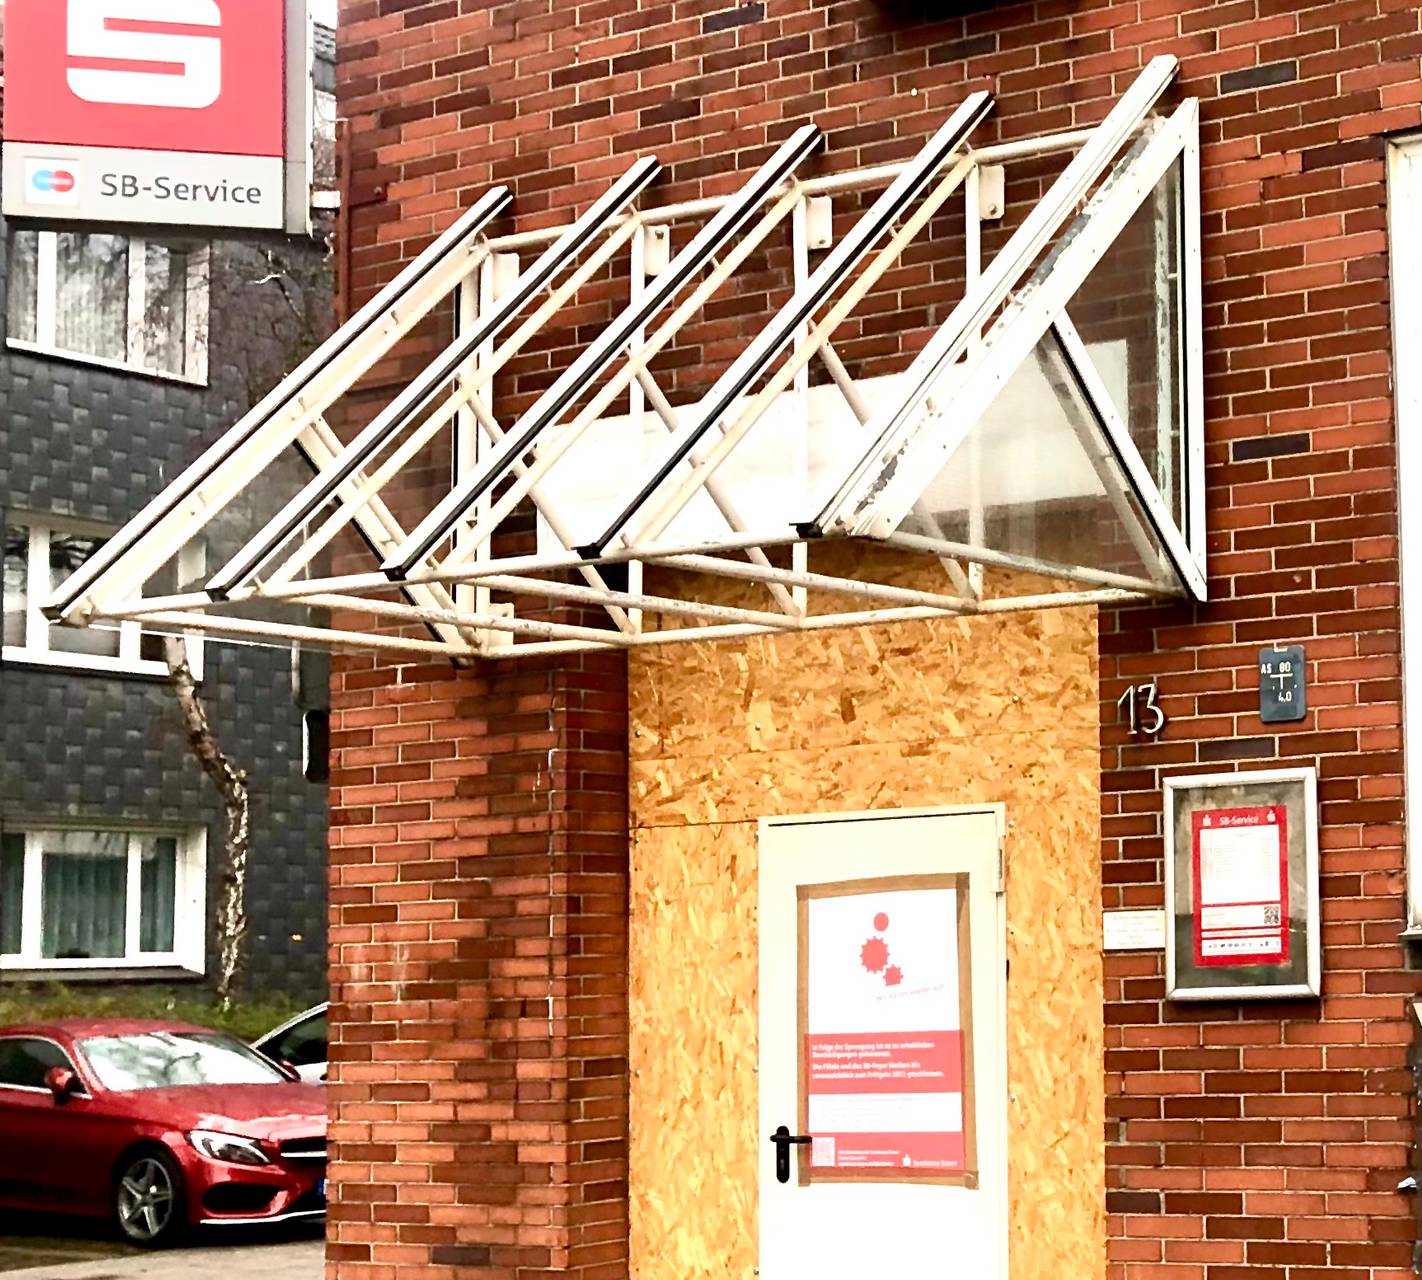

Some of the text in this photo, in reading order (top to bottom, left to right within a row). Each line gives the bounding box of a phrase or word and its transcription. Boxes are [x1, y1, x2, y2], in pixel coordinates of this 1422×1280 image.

[101, 173, 262, 204] SB-Service
[1260, 661, 1291, 674] AS 80
[1117, 683, 1164, 734] 13
[1219, 814, 1260, 825] SB-Service
